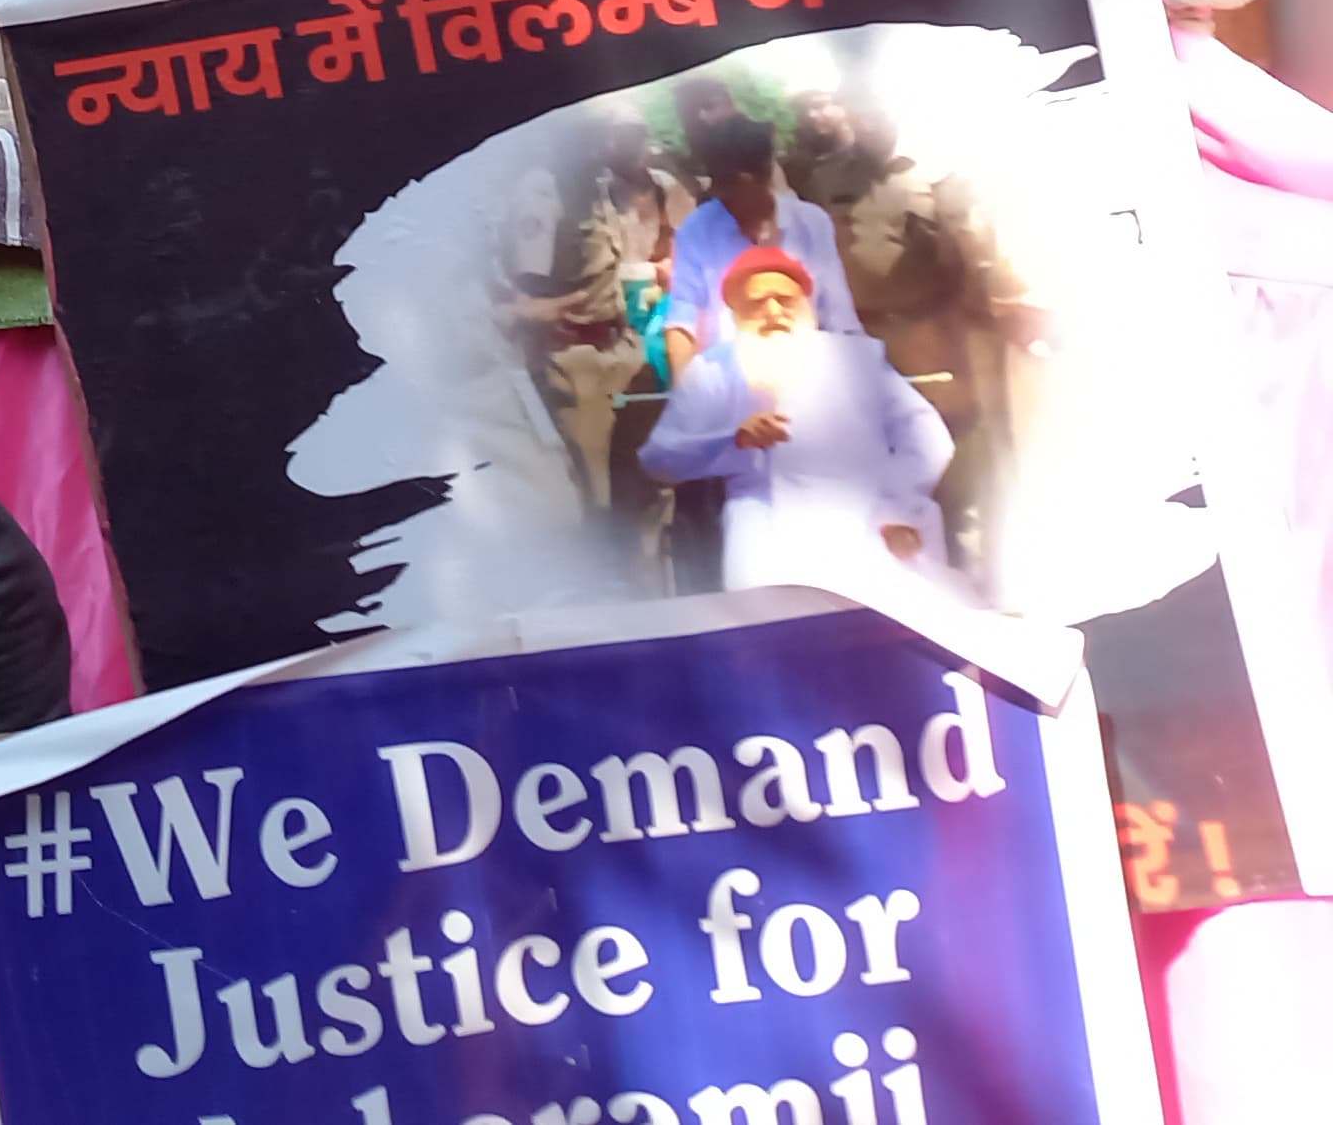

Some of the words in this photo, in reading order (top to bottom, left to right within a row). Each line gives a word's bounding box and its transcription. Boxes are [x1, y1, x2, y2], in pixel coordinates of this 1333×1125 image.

[53, 26, 284, 127] न्याय
[4, 765, 339, 918] #We
[377, 670, 1007, 873] Demand
[135, 909, 654, 1079] Justice
[698, 867, 921, 1005] for
